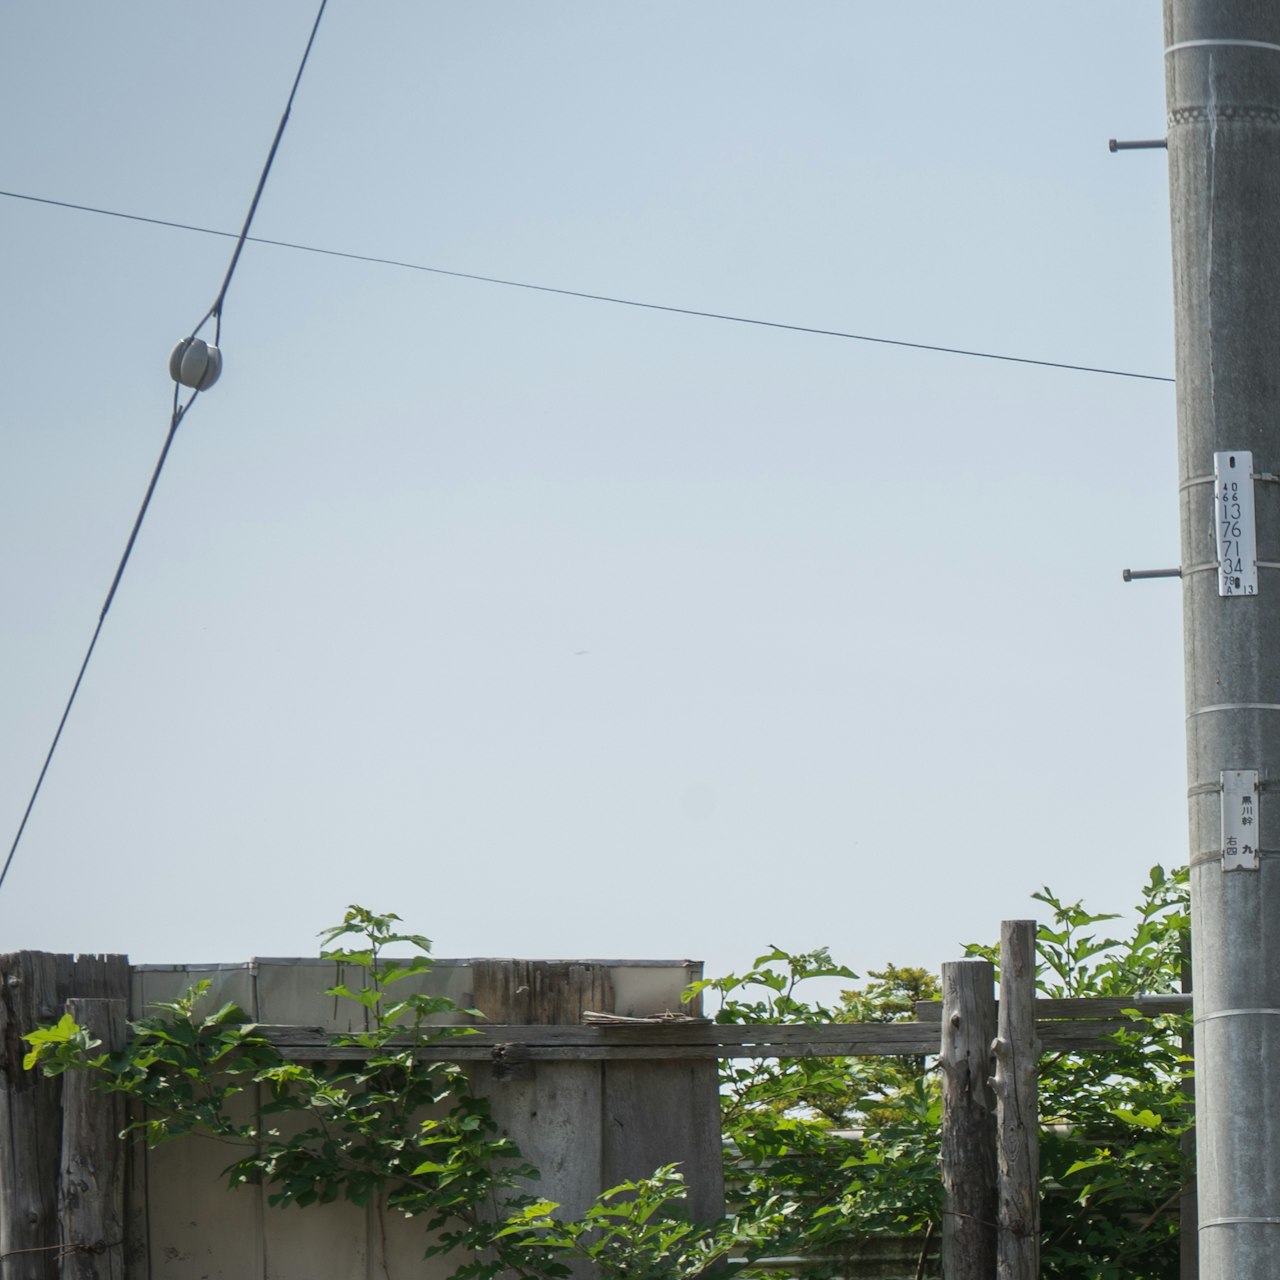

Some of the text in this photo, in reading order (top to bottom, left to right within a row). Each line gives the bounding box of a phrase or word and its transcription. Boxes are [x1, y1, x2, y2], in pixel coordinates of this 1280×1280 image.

[1223, 503, 1241, 520] 13
[1222, 521, 1242, 538] 76
[1222, 540, 1240, 557] 71
[1223, 558, 1243, 574] 34
